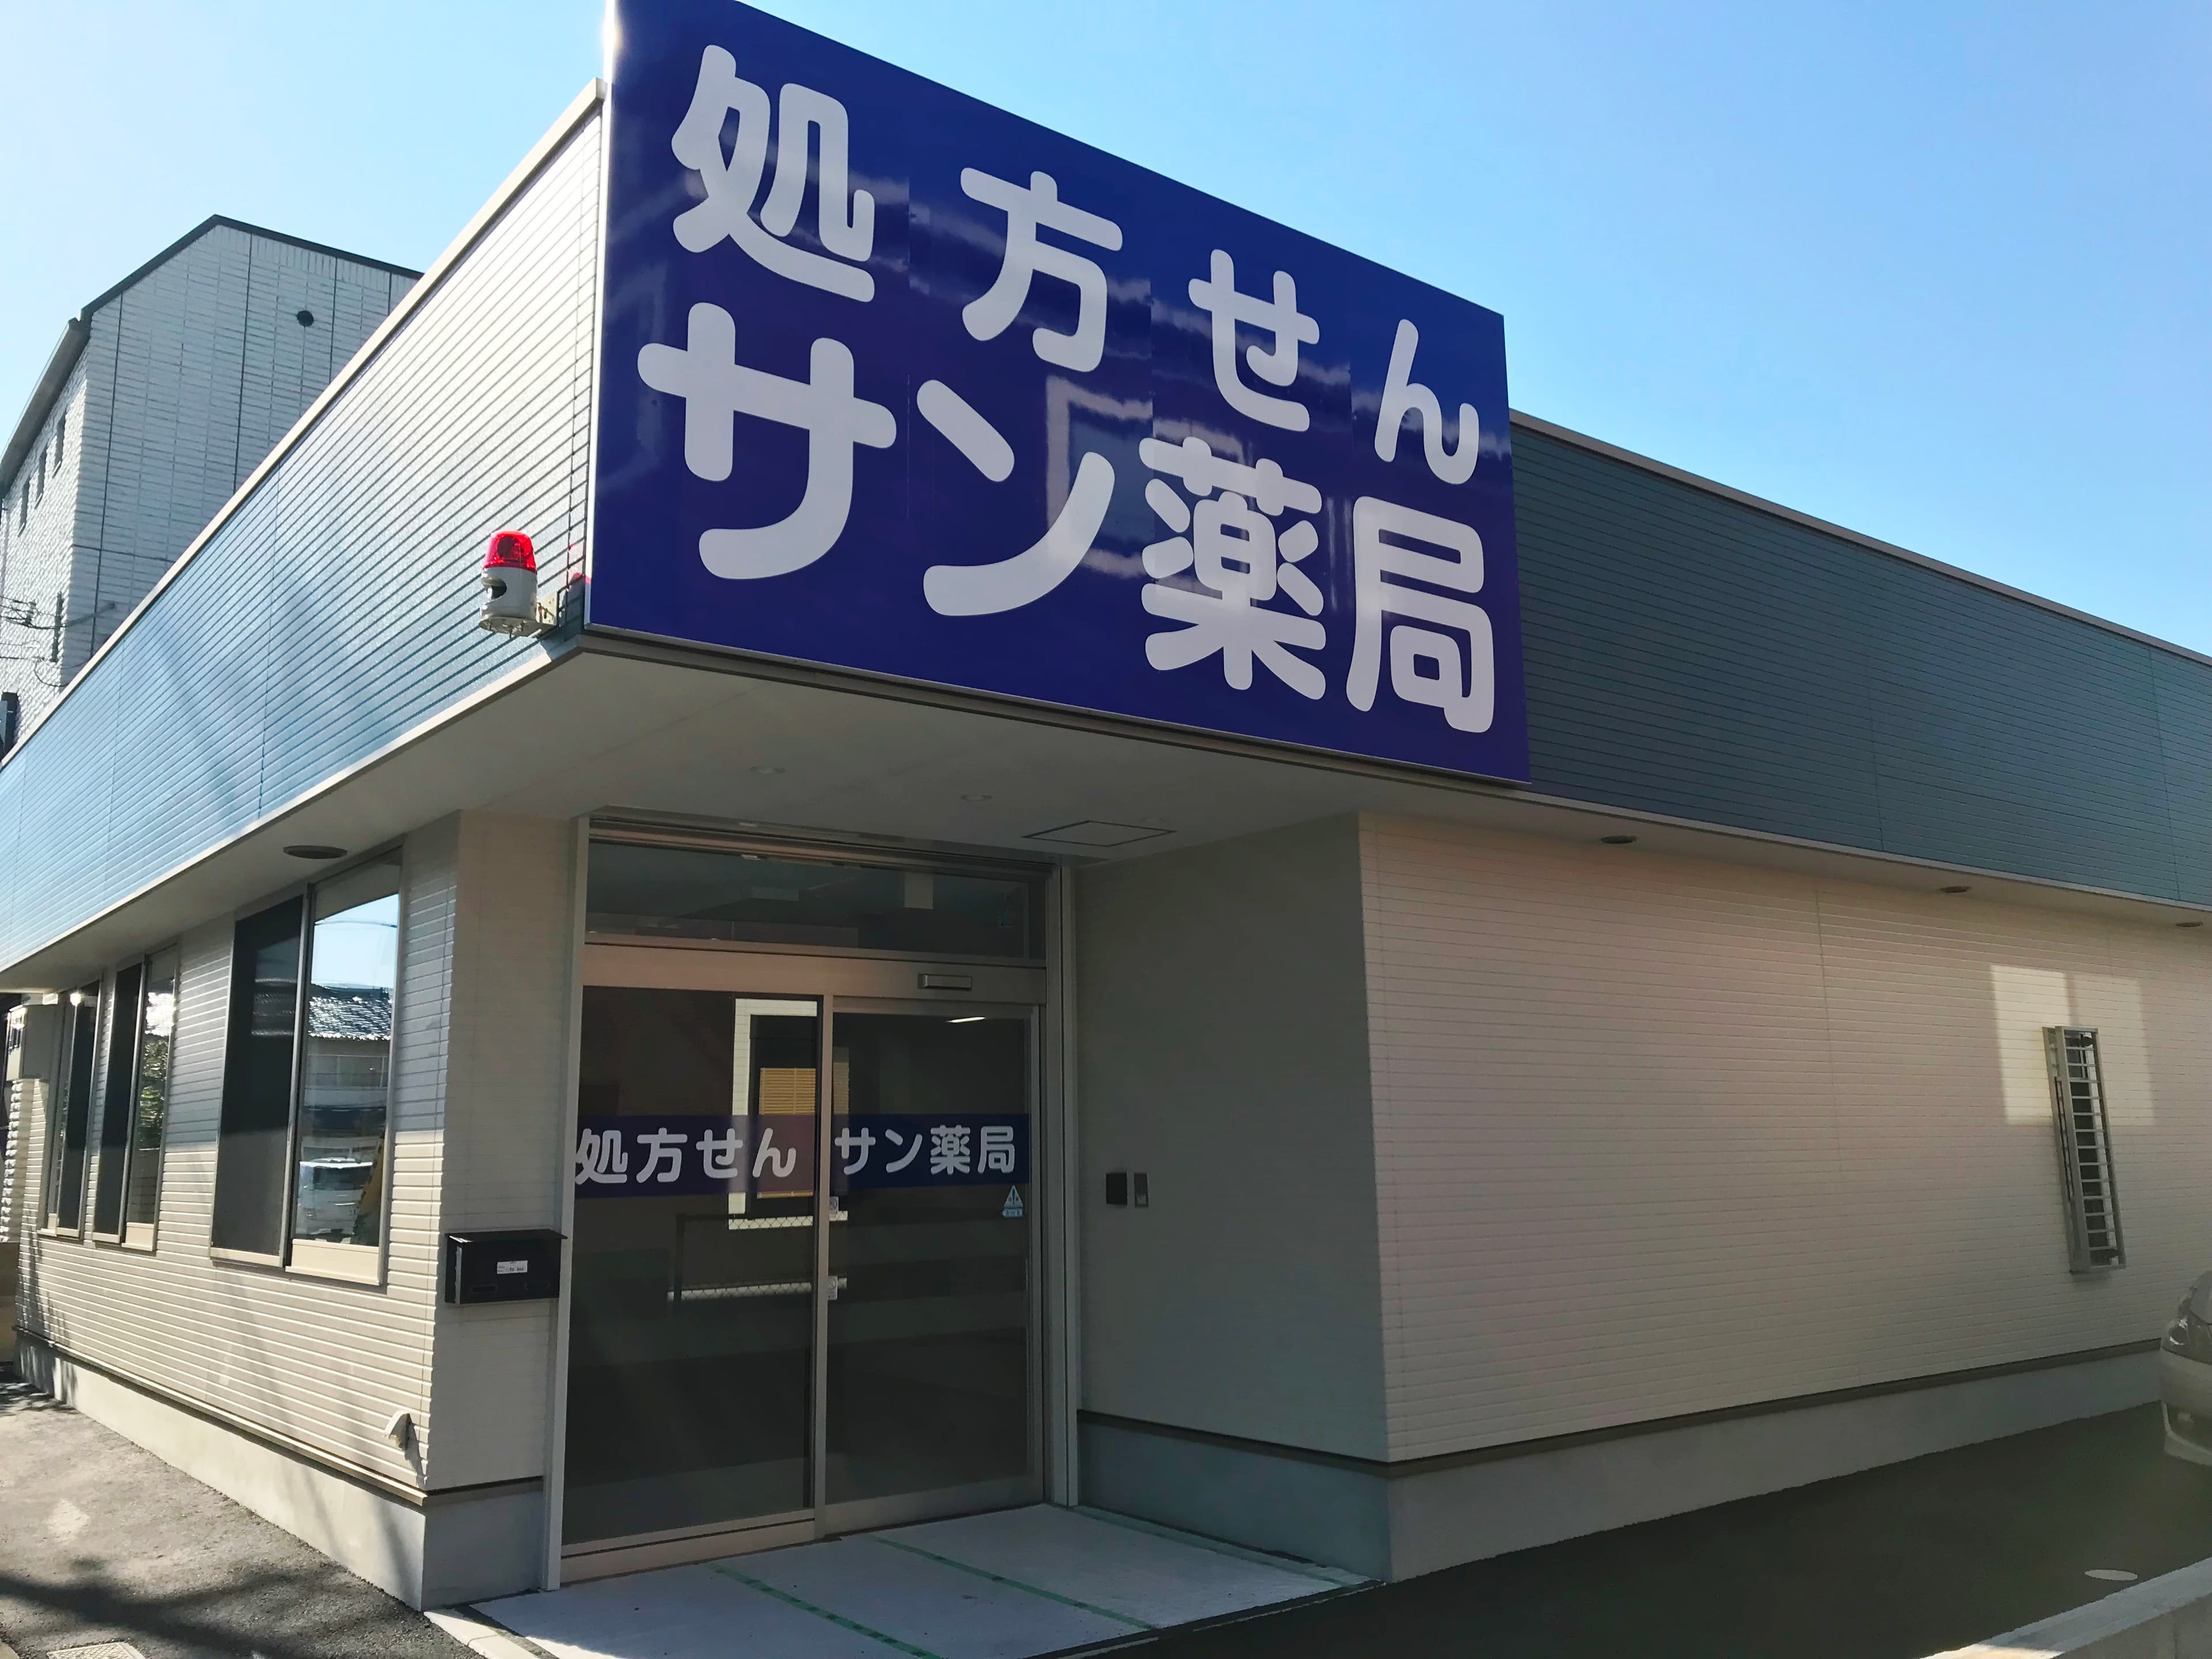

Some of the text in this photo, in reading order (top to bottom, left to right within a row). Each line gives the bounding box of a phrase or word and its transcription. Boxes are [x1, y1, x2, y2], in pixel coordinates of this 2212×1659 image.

[671, 44, 1480, 485] 処方せん
[637, 302, 1494, 733] サン薬局
[575, 1124, 1015, 1185] 処方せん サン薬局
